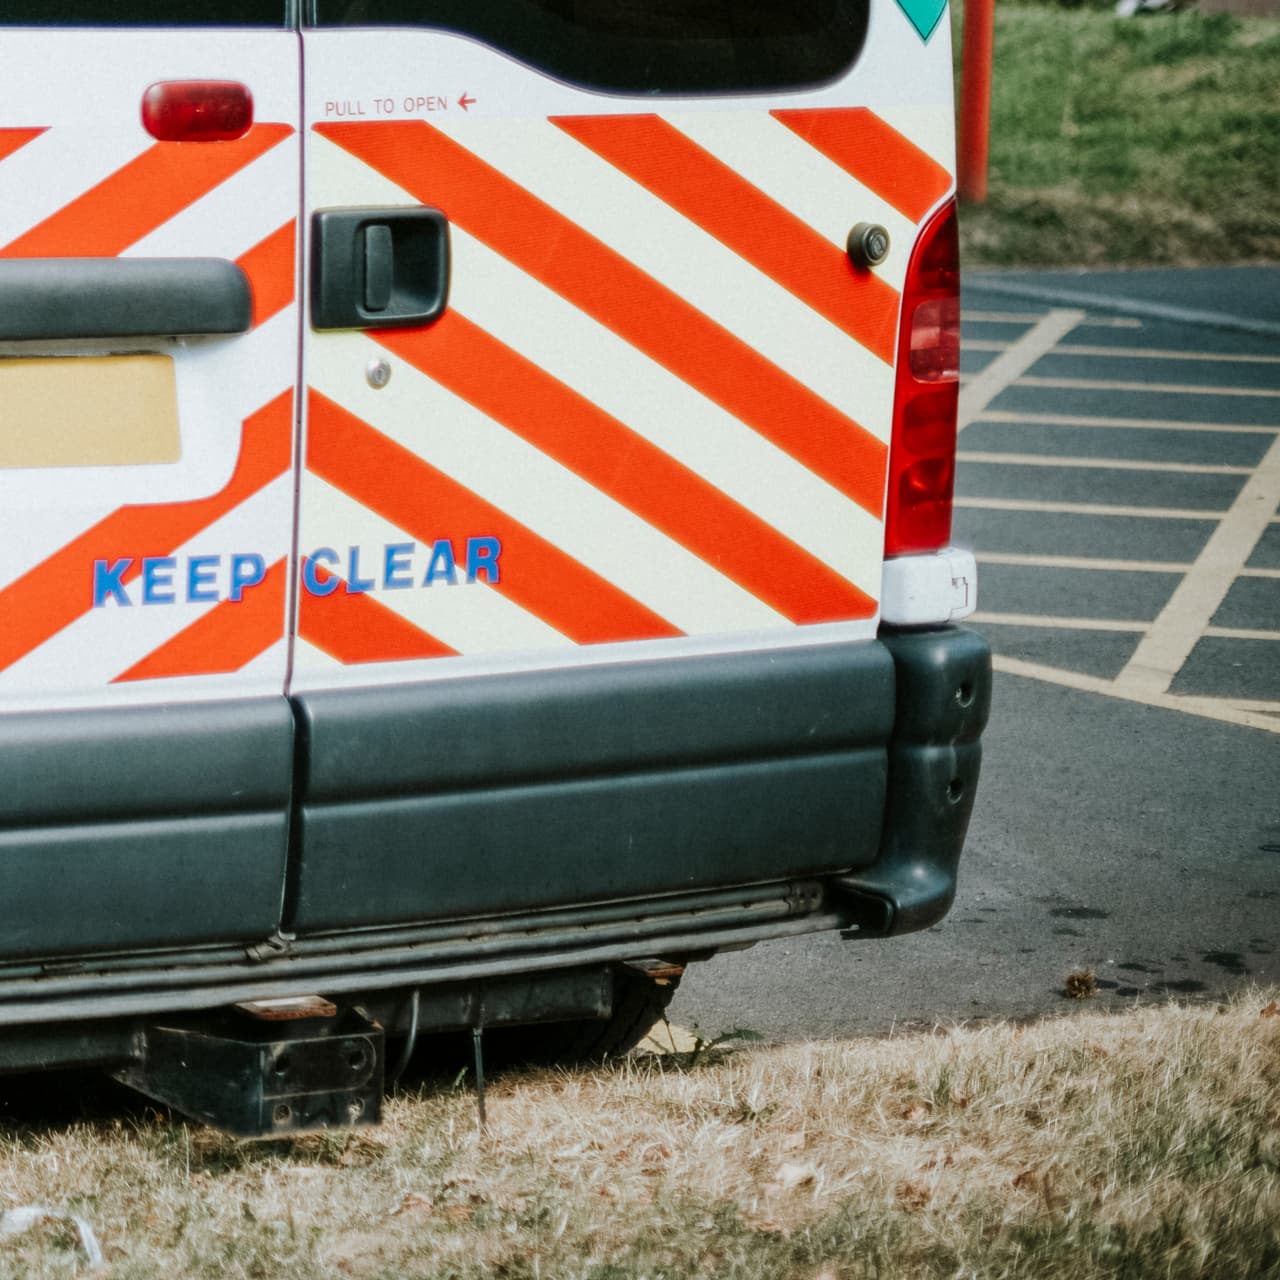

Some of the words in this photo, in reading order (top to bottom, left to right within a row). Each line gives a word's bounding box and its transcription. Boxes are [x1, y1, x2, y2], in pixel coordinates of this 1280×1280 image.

[324, 100, 366, 117] PULL
[373, 98, 395, 114] TO
[403, 96, 448, 113] OPEN
[92, 552, 267, 609] KEEP
[301, 535, 502, 598] CLEAR
